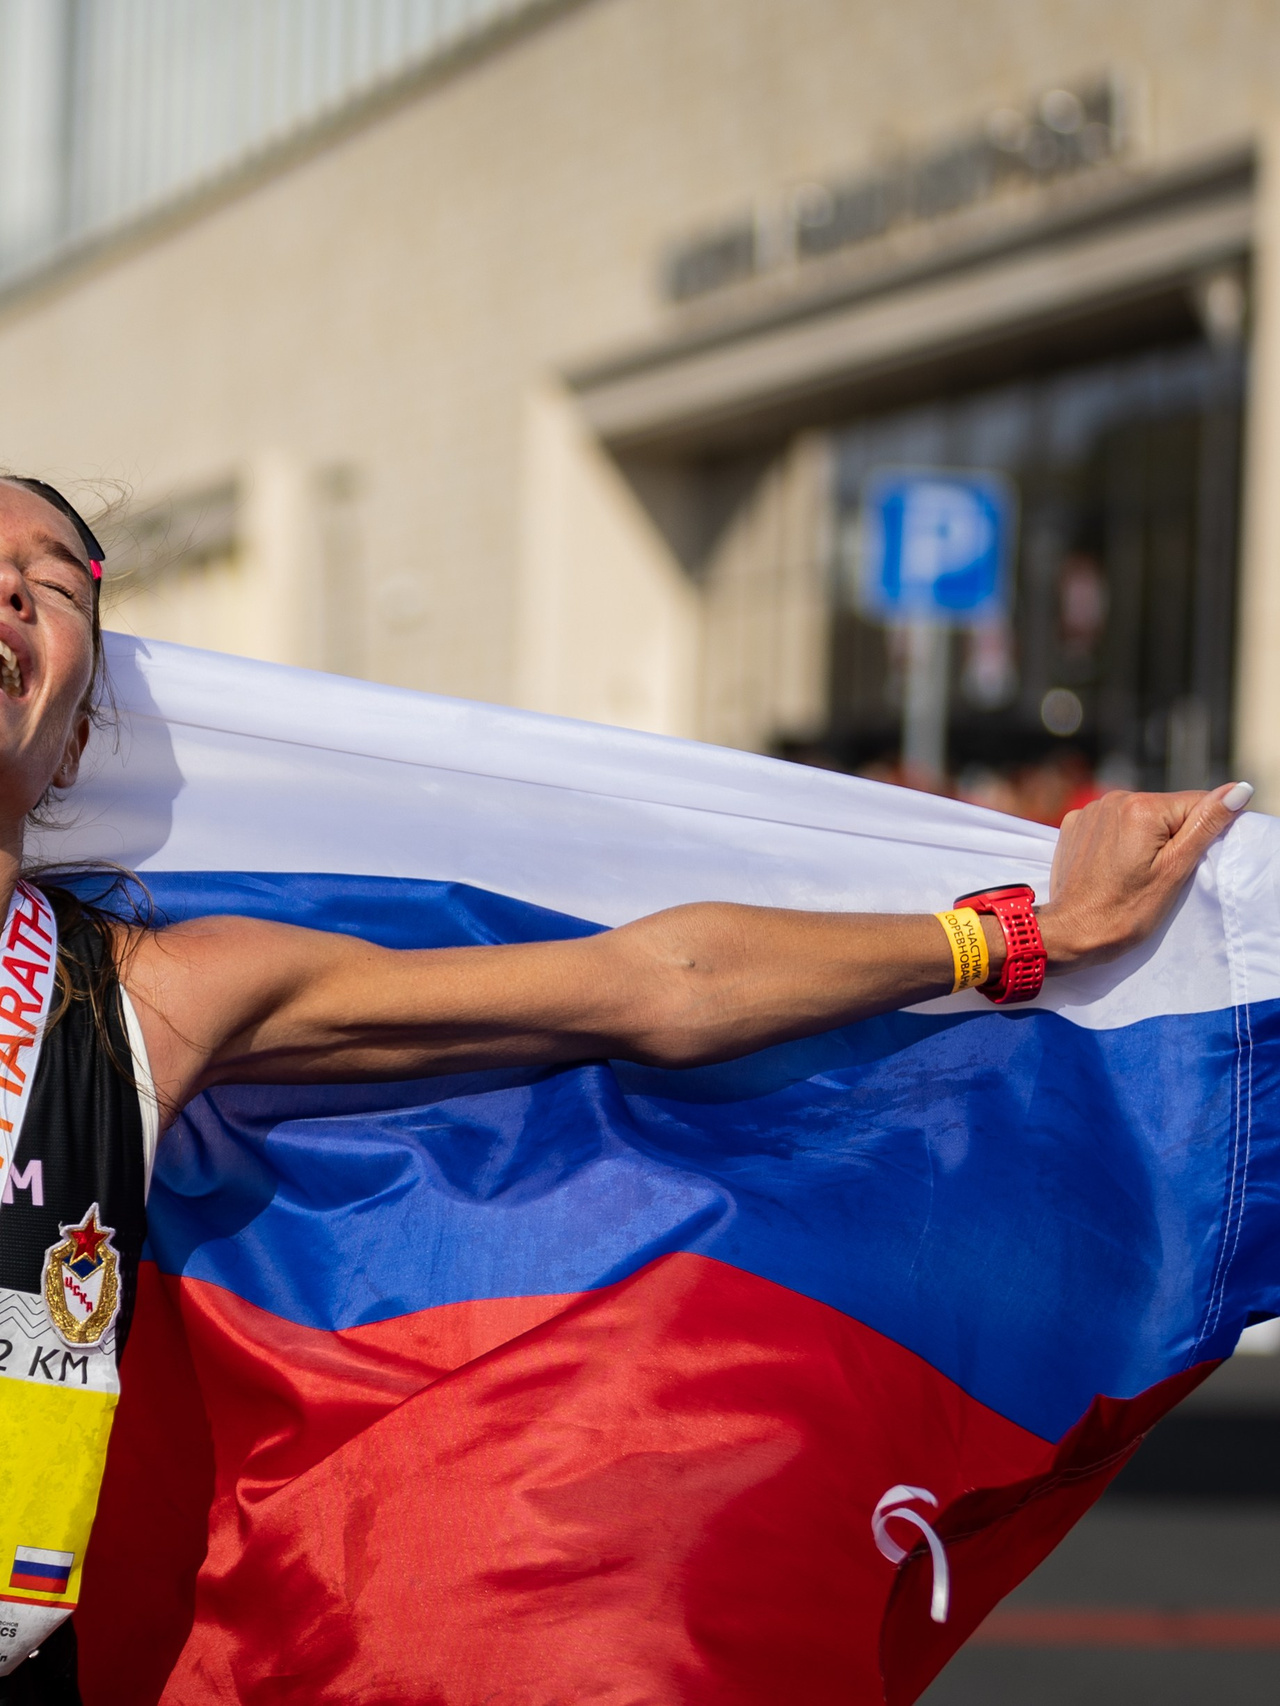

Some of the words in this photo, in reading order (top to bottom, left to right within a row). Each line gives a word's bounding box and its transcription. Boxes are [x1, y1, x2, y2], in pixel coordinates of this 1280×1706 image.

[901, 482, 997, 588] P
[945, 913, 971, 989] СОРЕВНОВАНИ
[962, 920, 982, 980] УЧАСТНИК
[64, 1276, 94, 1314] ЦСКА
